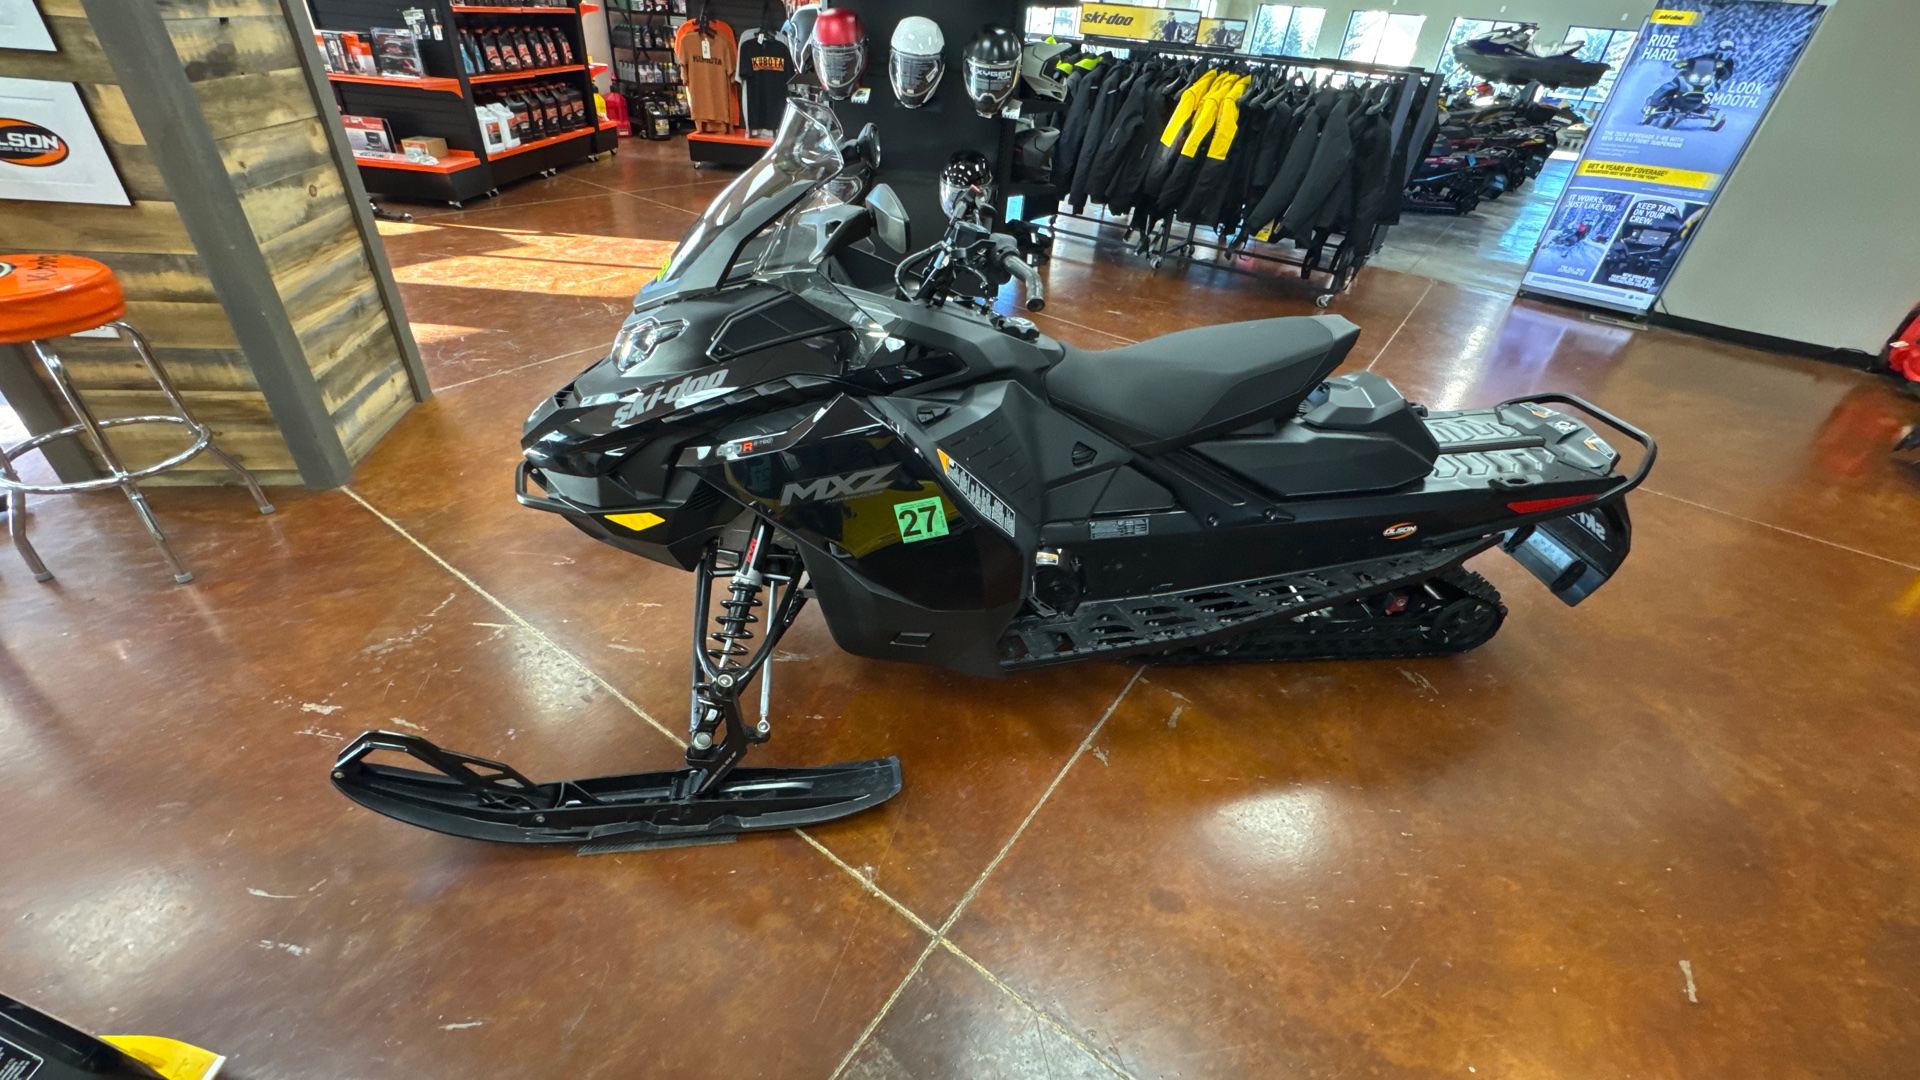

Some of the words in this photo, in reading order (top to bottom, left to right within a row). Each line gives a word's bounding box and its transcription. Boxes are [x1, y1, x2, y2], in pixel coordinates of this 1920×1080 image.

[1082, 11, 1135, 26] ski-doo
[1647, 33, 1680, 48] RIDE
[1641, 46, 1678, 61] HARD.
[752, 57, 784, 67] KUBOTA
[1727, 80, 1766, 95] LOOK
[1701, 92, 1759, 108] SMOOTH.
[1587, 162, 1599, 170] GET
[1605, 164, 1625, 172] YEARS
[1565, 200, 1583, 209] JUST
[1584, 201, 1601, 210] LIKE
[1601, 203, 1617, 212] YOU.
[1568, 193, 1577, 201] IT
[1577, 194, 1604, 204] WORKS.
[1632, 208, 1645, 217] ON
[1645, 210, 1665, 220] YOUR
[1636, 202, 1657, 211] KEEP
[1657, 204, 1677, 214] TABS
[1629, 215, 1653, 224] CREW.
[611, 369, 729, 427] ski-doo
[780, 462, 900, 507] MXZ
[899, 505, 937, 537] 27
